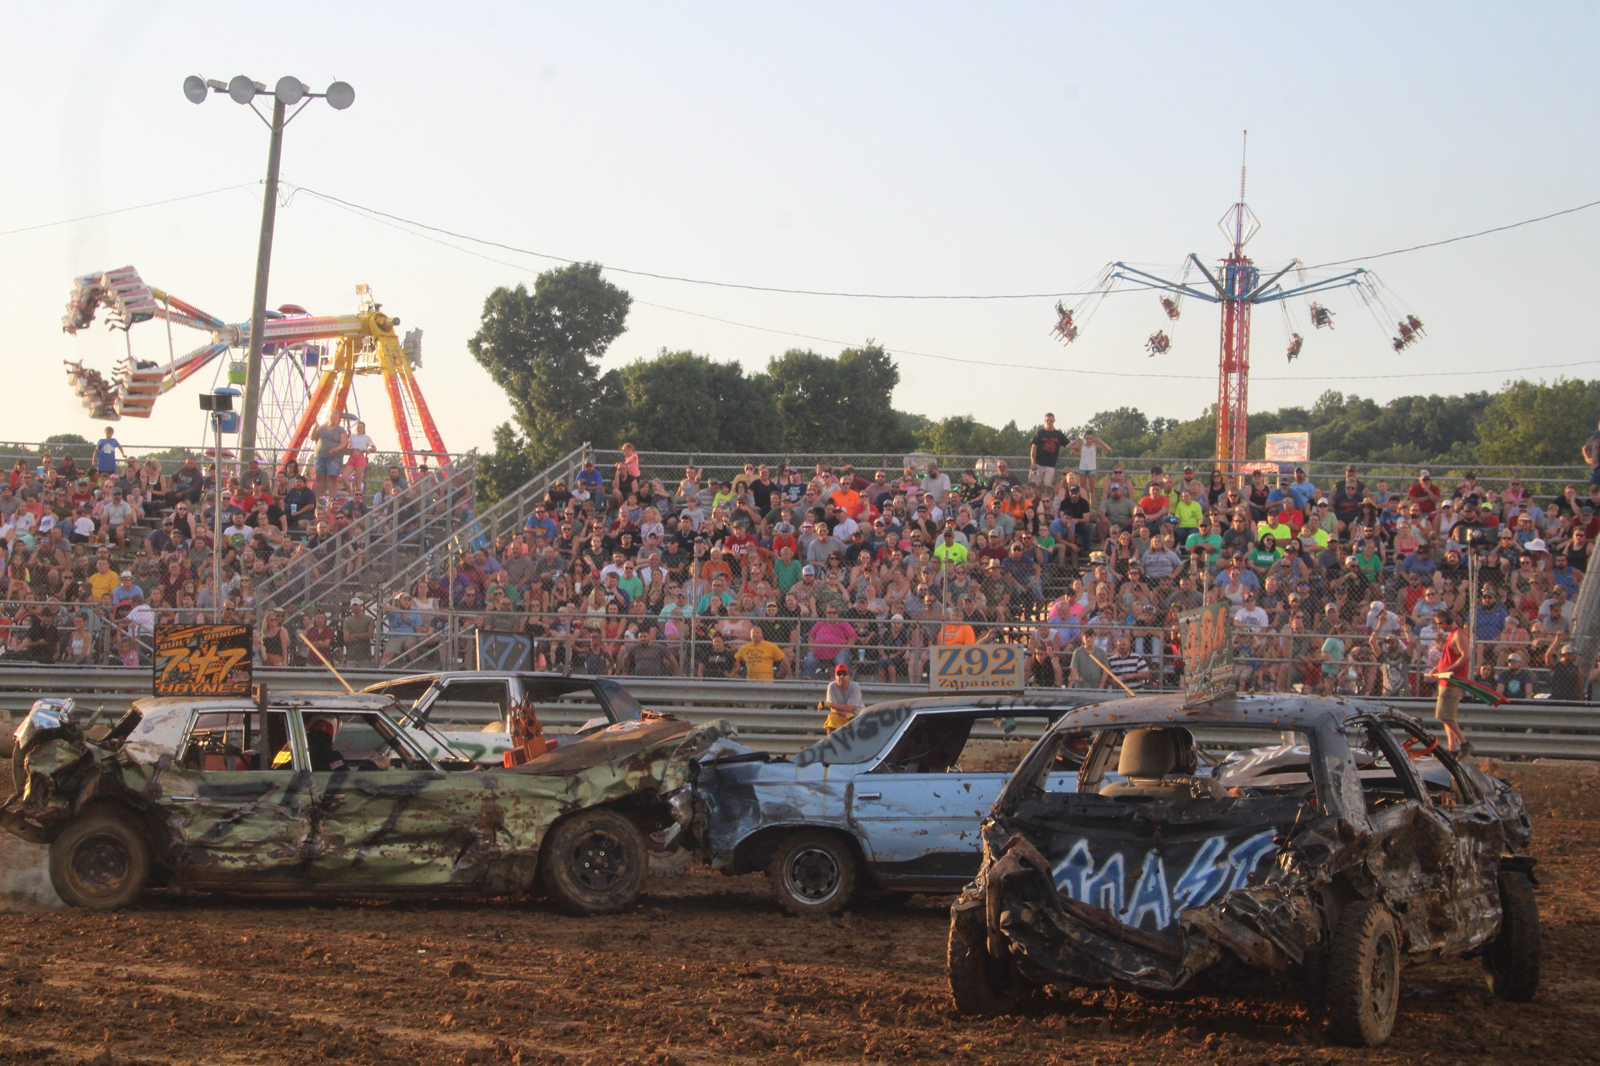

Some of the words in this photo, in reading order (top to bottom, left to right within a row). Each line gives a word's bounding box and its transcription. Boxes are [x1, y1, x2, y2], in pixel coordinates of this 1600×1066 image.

[160, 638, 192, 650] BUILT
[204, 628, 246, 640] BANGIN
[1184, 607, 1227, 671] 484
[160, 645, 247, 684] 747
[480, 634, 532, 671] K77
[936, 646, 1017, 677] Z92
[158, 684, 247, 693] HAYNES
